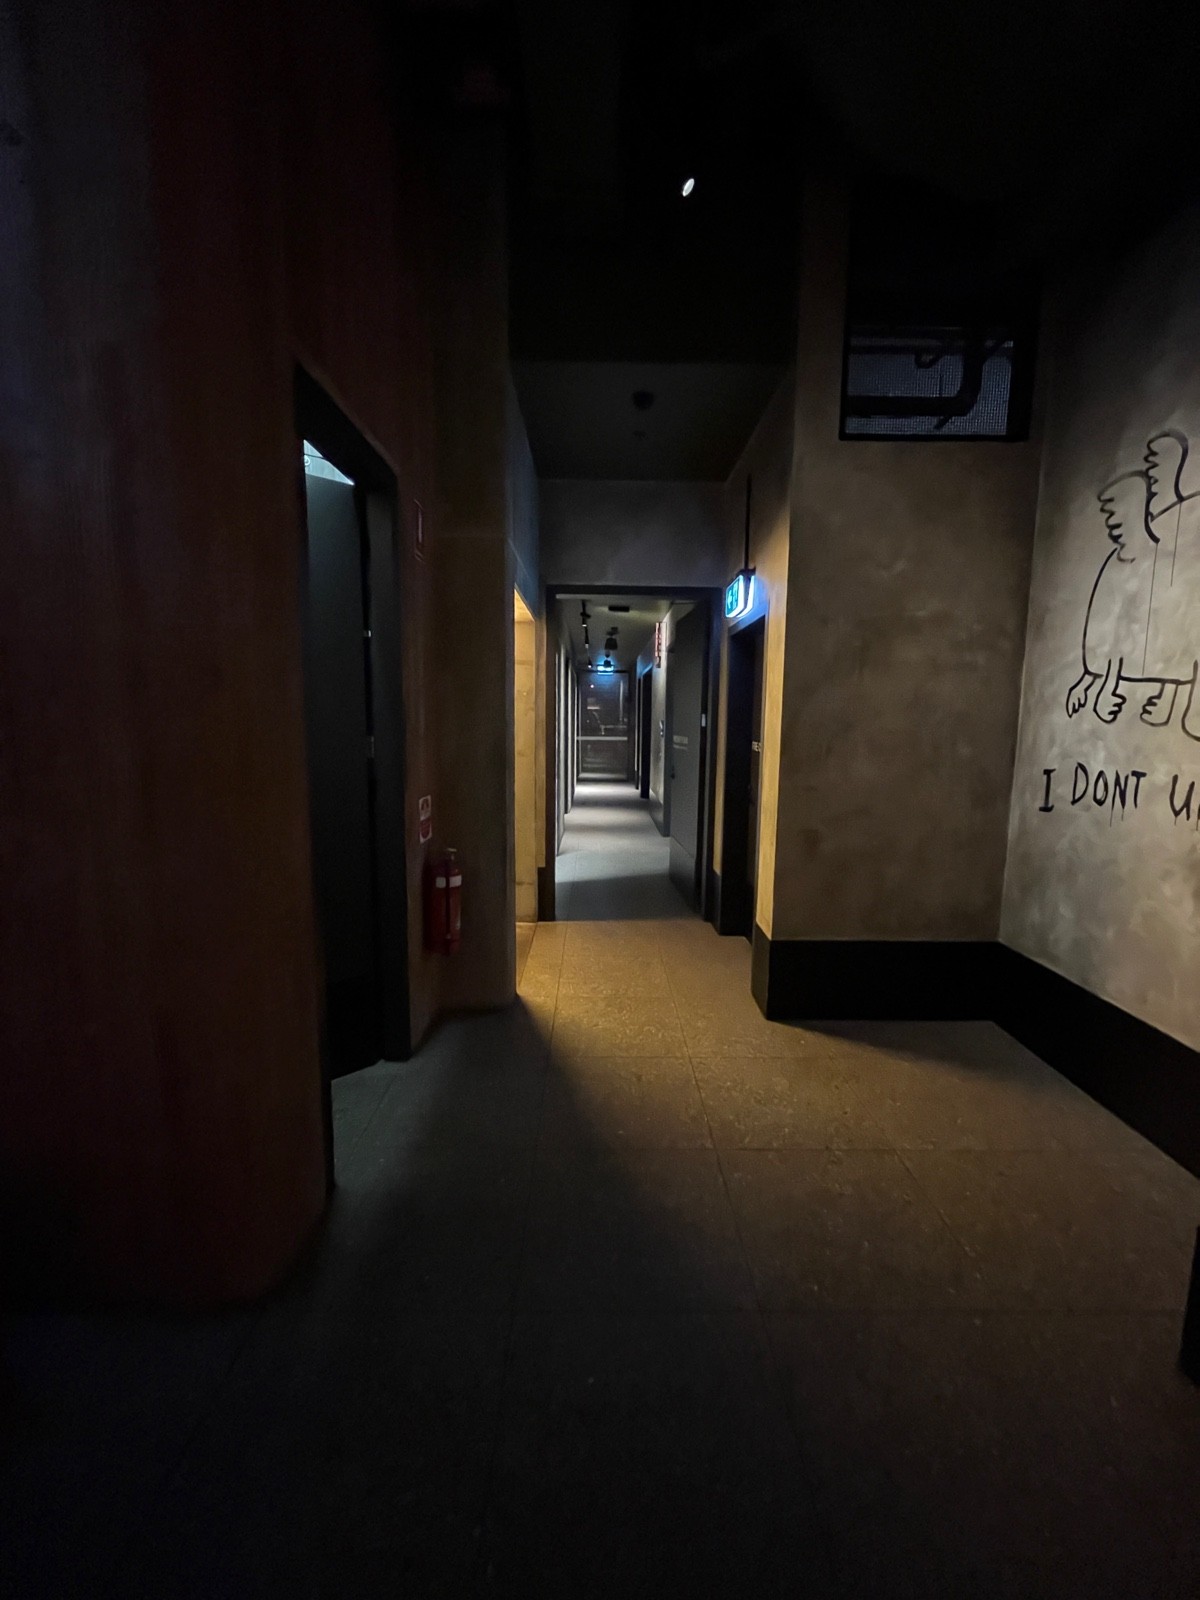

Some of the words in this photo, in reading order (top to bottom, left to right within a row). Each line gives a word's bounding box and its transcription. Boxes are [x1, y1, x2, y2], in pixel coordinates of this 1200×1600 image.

[1039, 768, 1056, 813] I
[1070, 761, 1148, 812] DONT
[1168, 773, 1200, 823] U
